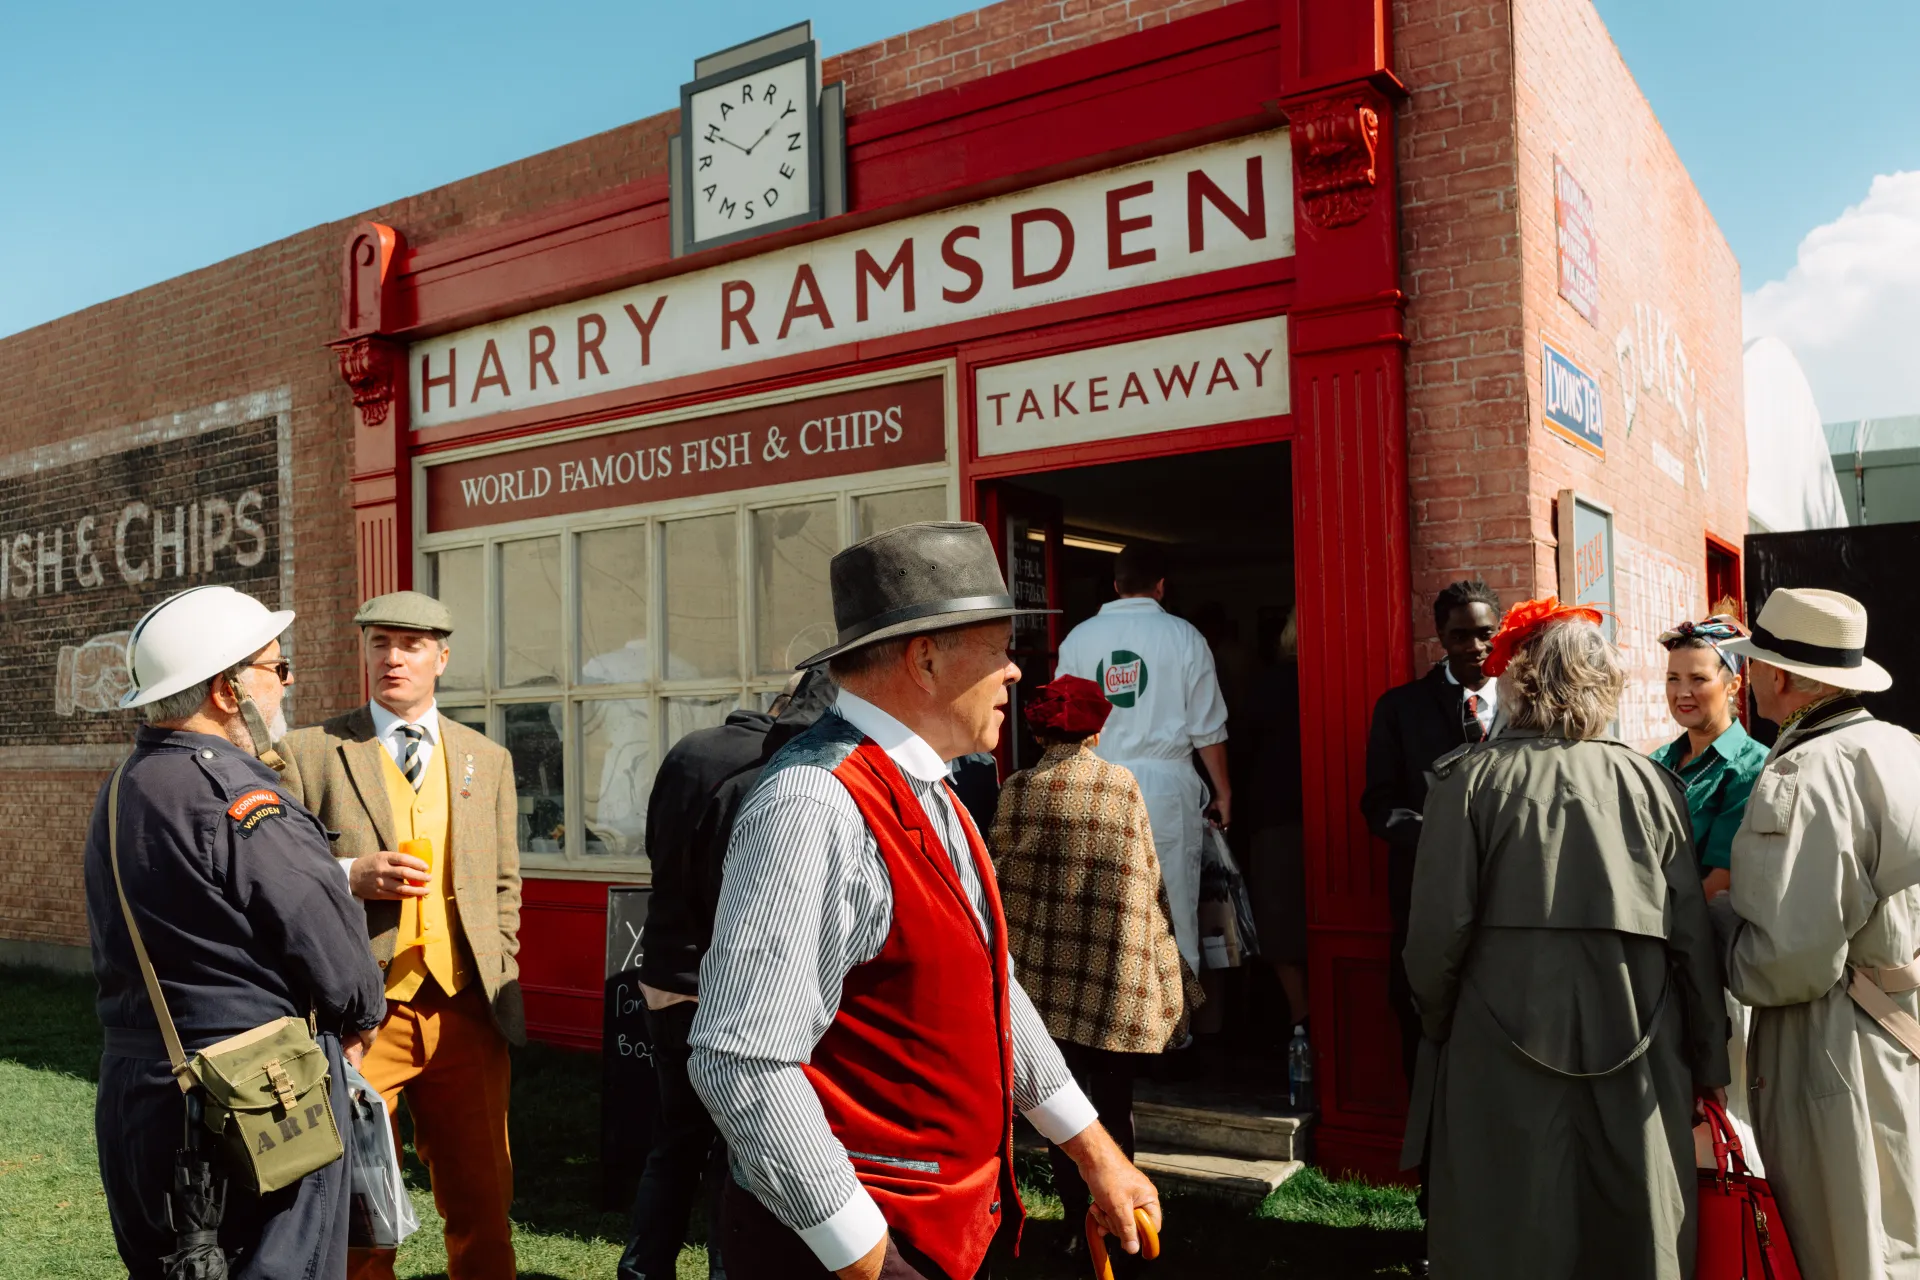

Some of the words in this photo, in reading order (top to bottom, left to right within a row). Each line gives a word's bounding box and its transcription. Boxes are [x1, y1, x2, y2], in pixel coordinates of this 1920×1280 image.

[704, 84, 797, 144] HARRY
[699, 132, 801, 219] RAMSDEN
[422, 295, 668, 413] HARRY
[720, 155, 1267, 350] RAMSDEN
[986, 348, 1273, 427] TAKEAWAY
[1583, 376, 1602, 437] TEA
[460, 466, 551, 508] WORLD
[558, 445, 673, 493] FAMOUS
[681, 431, 752, 475] FISH
[762, 426, 790, 462] &
[800, 405, 903, 454] CHIPS
[0, 527, 64, 598] ISH
[76, 515, 104, 588] &
[115, 490, 266, 585] CHIPS
[1576, 531, 1605, 597] FISH
[1105, 661, 1139, 693] Castrol
[234, 793, 276, 815] CORNWALL
[243, 807, 280, 830] WARDEN
[257, 1103, 324, 1156] ARP
